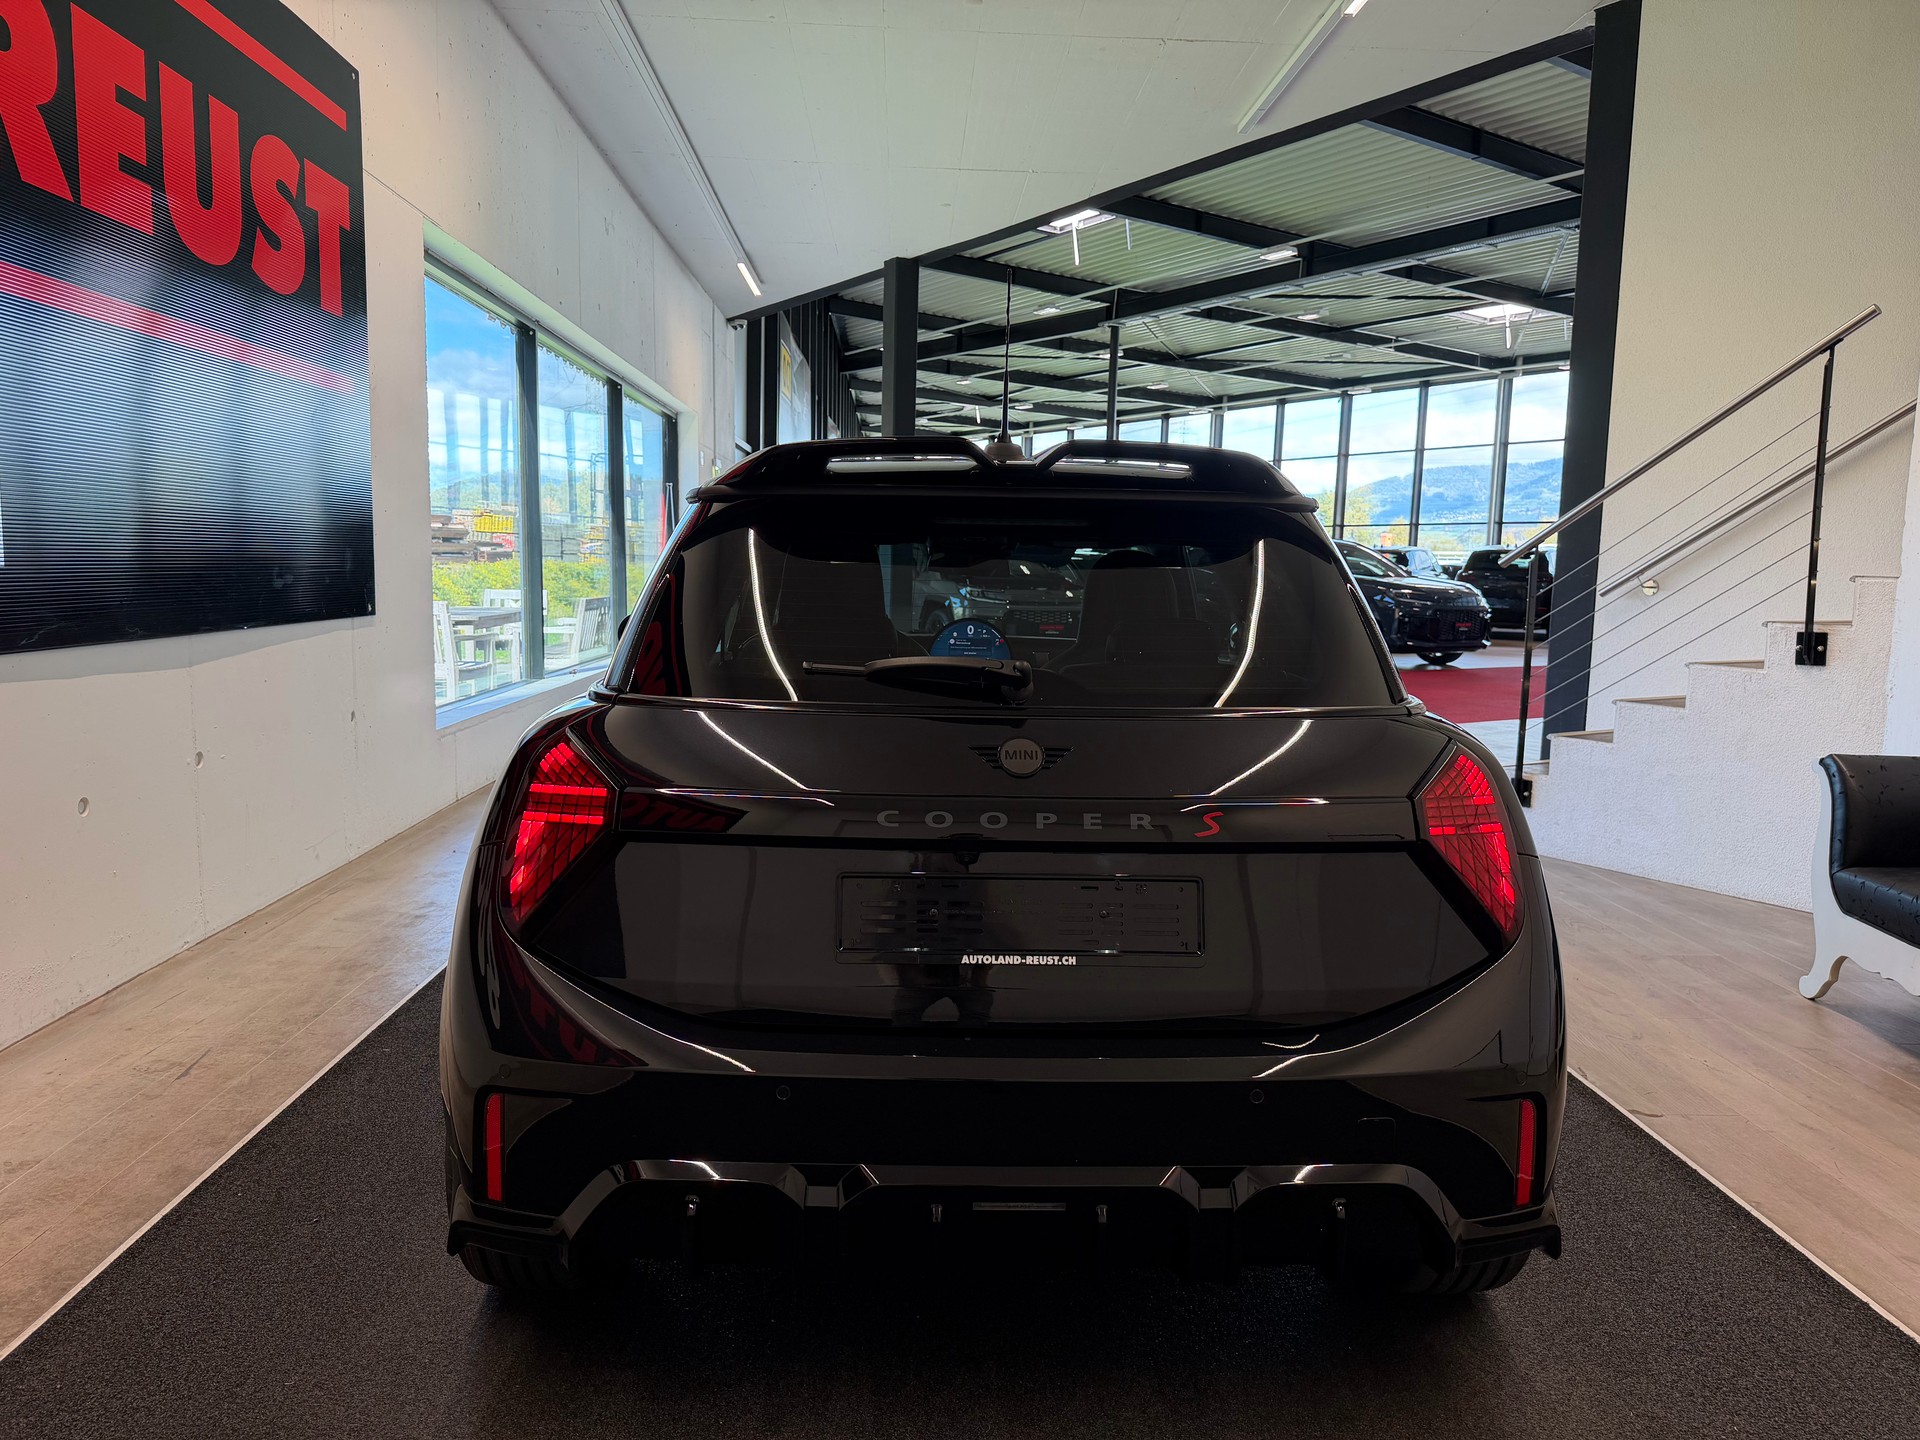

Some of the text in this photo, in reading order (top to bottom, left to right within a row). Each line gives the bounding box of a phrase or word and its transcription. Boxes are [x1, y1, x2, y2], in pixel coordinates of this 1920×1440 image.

[1004, 749, 1039, 761] MINI
[877, 810, 1225, 838] COOPER S
[961, 954, 1077, 967] AUTOLAND-REUST.CH
